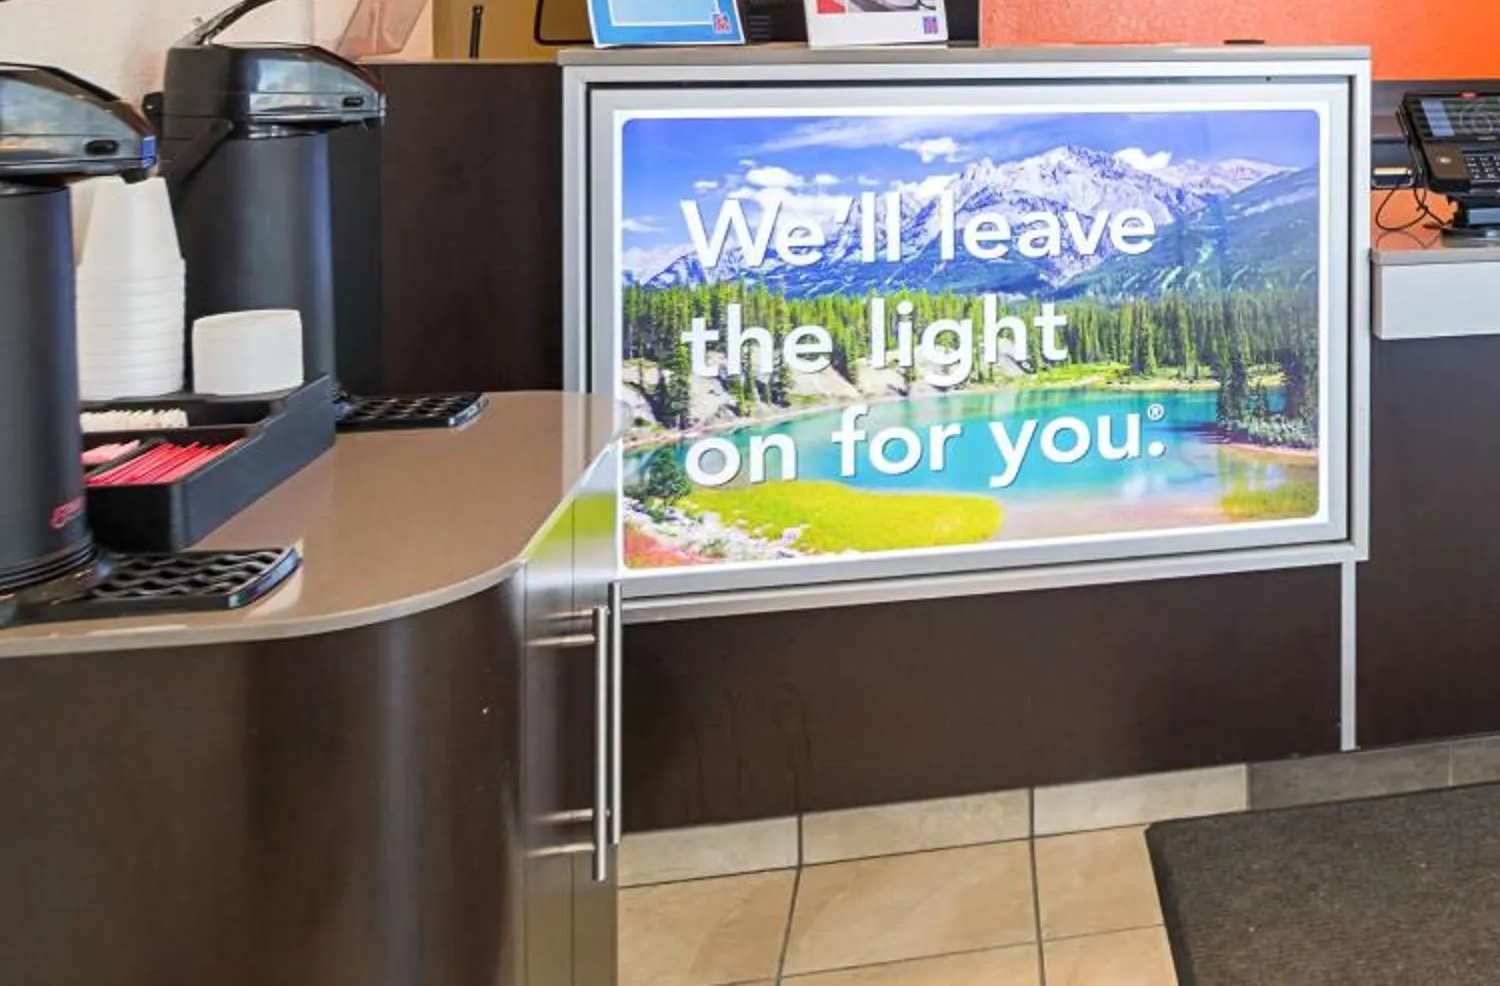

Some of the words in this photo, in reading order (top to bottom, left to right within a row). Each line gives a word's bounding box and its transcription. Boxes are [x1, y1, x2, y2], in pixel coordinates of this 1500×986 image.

[681, 194, 902, 269] We'll
[940, 193, 1157, 261] leave
[683, 305, 832, 378] the
[870, 295, 1068, 388] light
[685, 427, 797, 487] on
[833, 406, 963, 477] for
